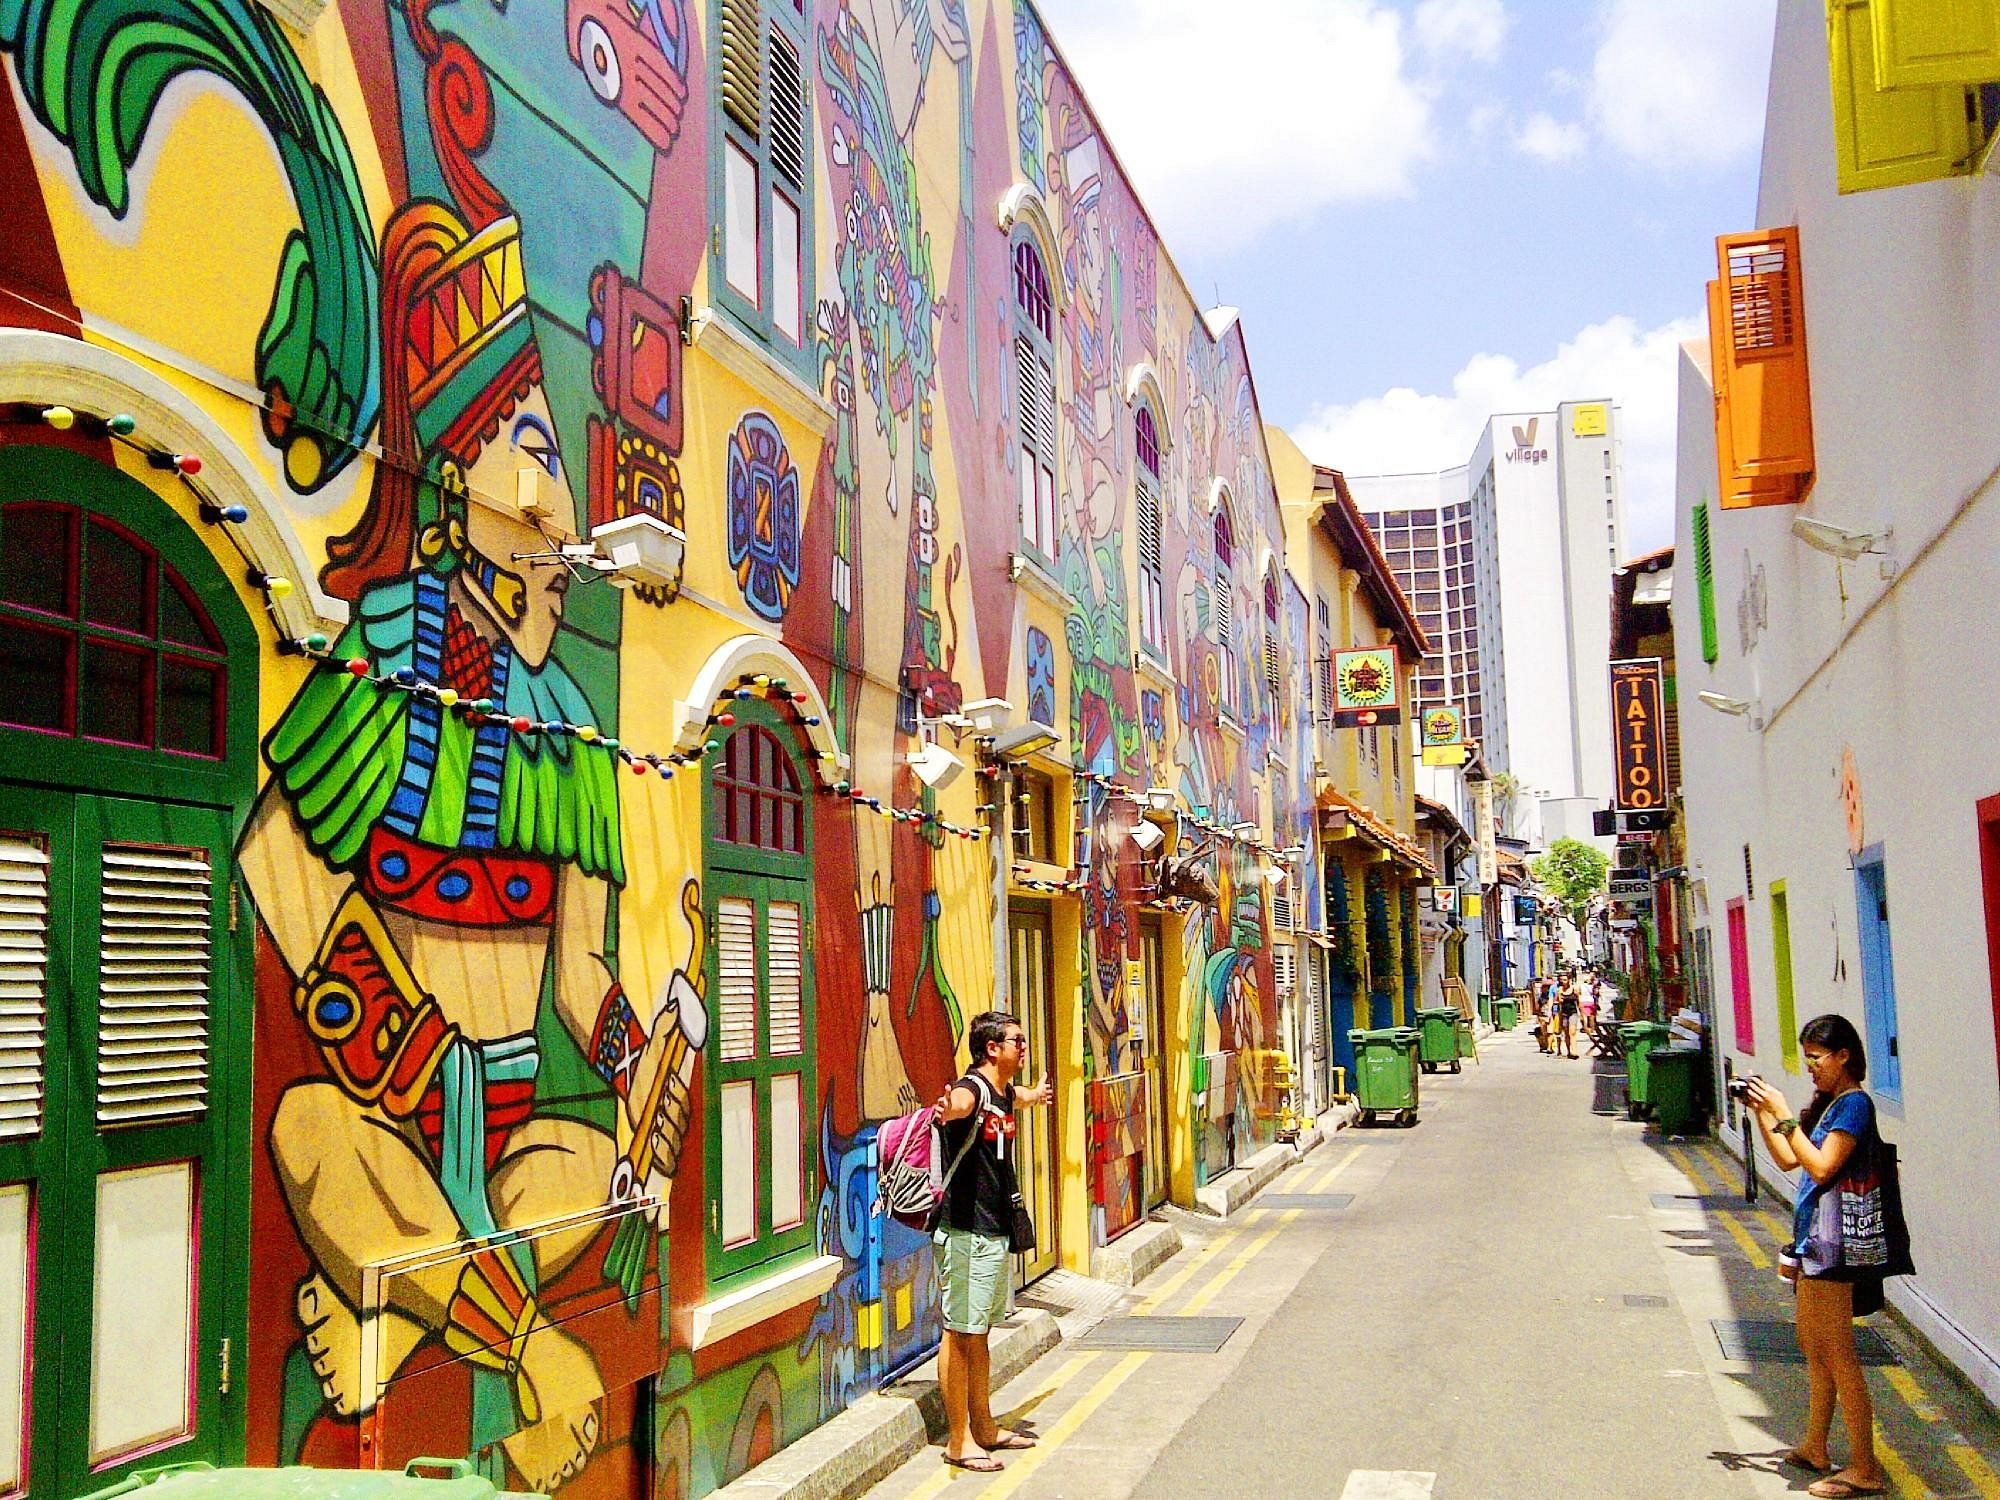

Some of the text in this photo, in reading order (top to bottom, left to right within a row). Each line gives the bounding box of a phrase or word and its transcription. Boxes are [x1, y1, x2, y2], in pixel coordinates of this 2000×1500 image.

[1505, 448, 1548, 464] village
[1626, 677, 1652, 808] TATTOO
[1609, 882, 1649, 894] BERGS
